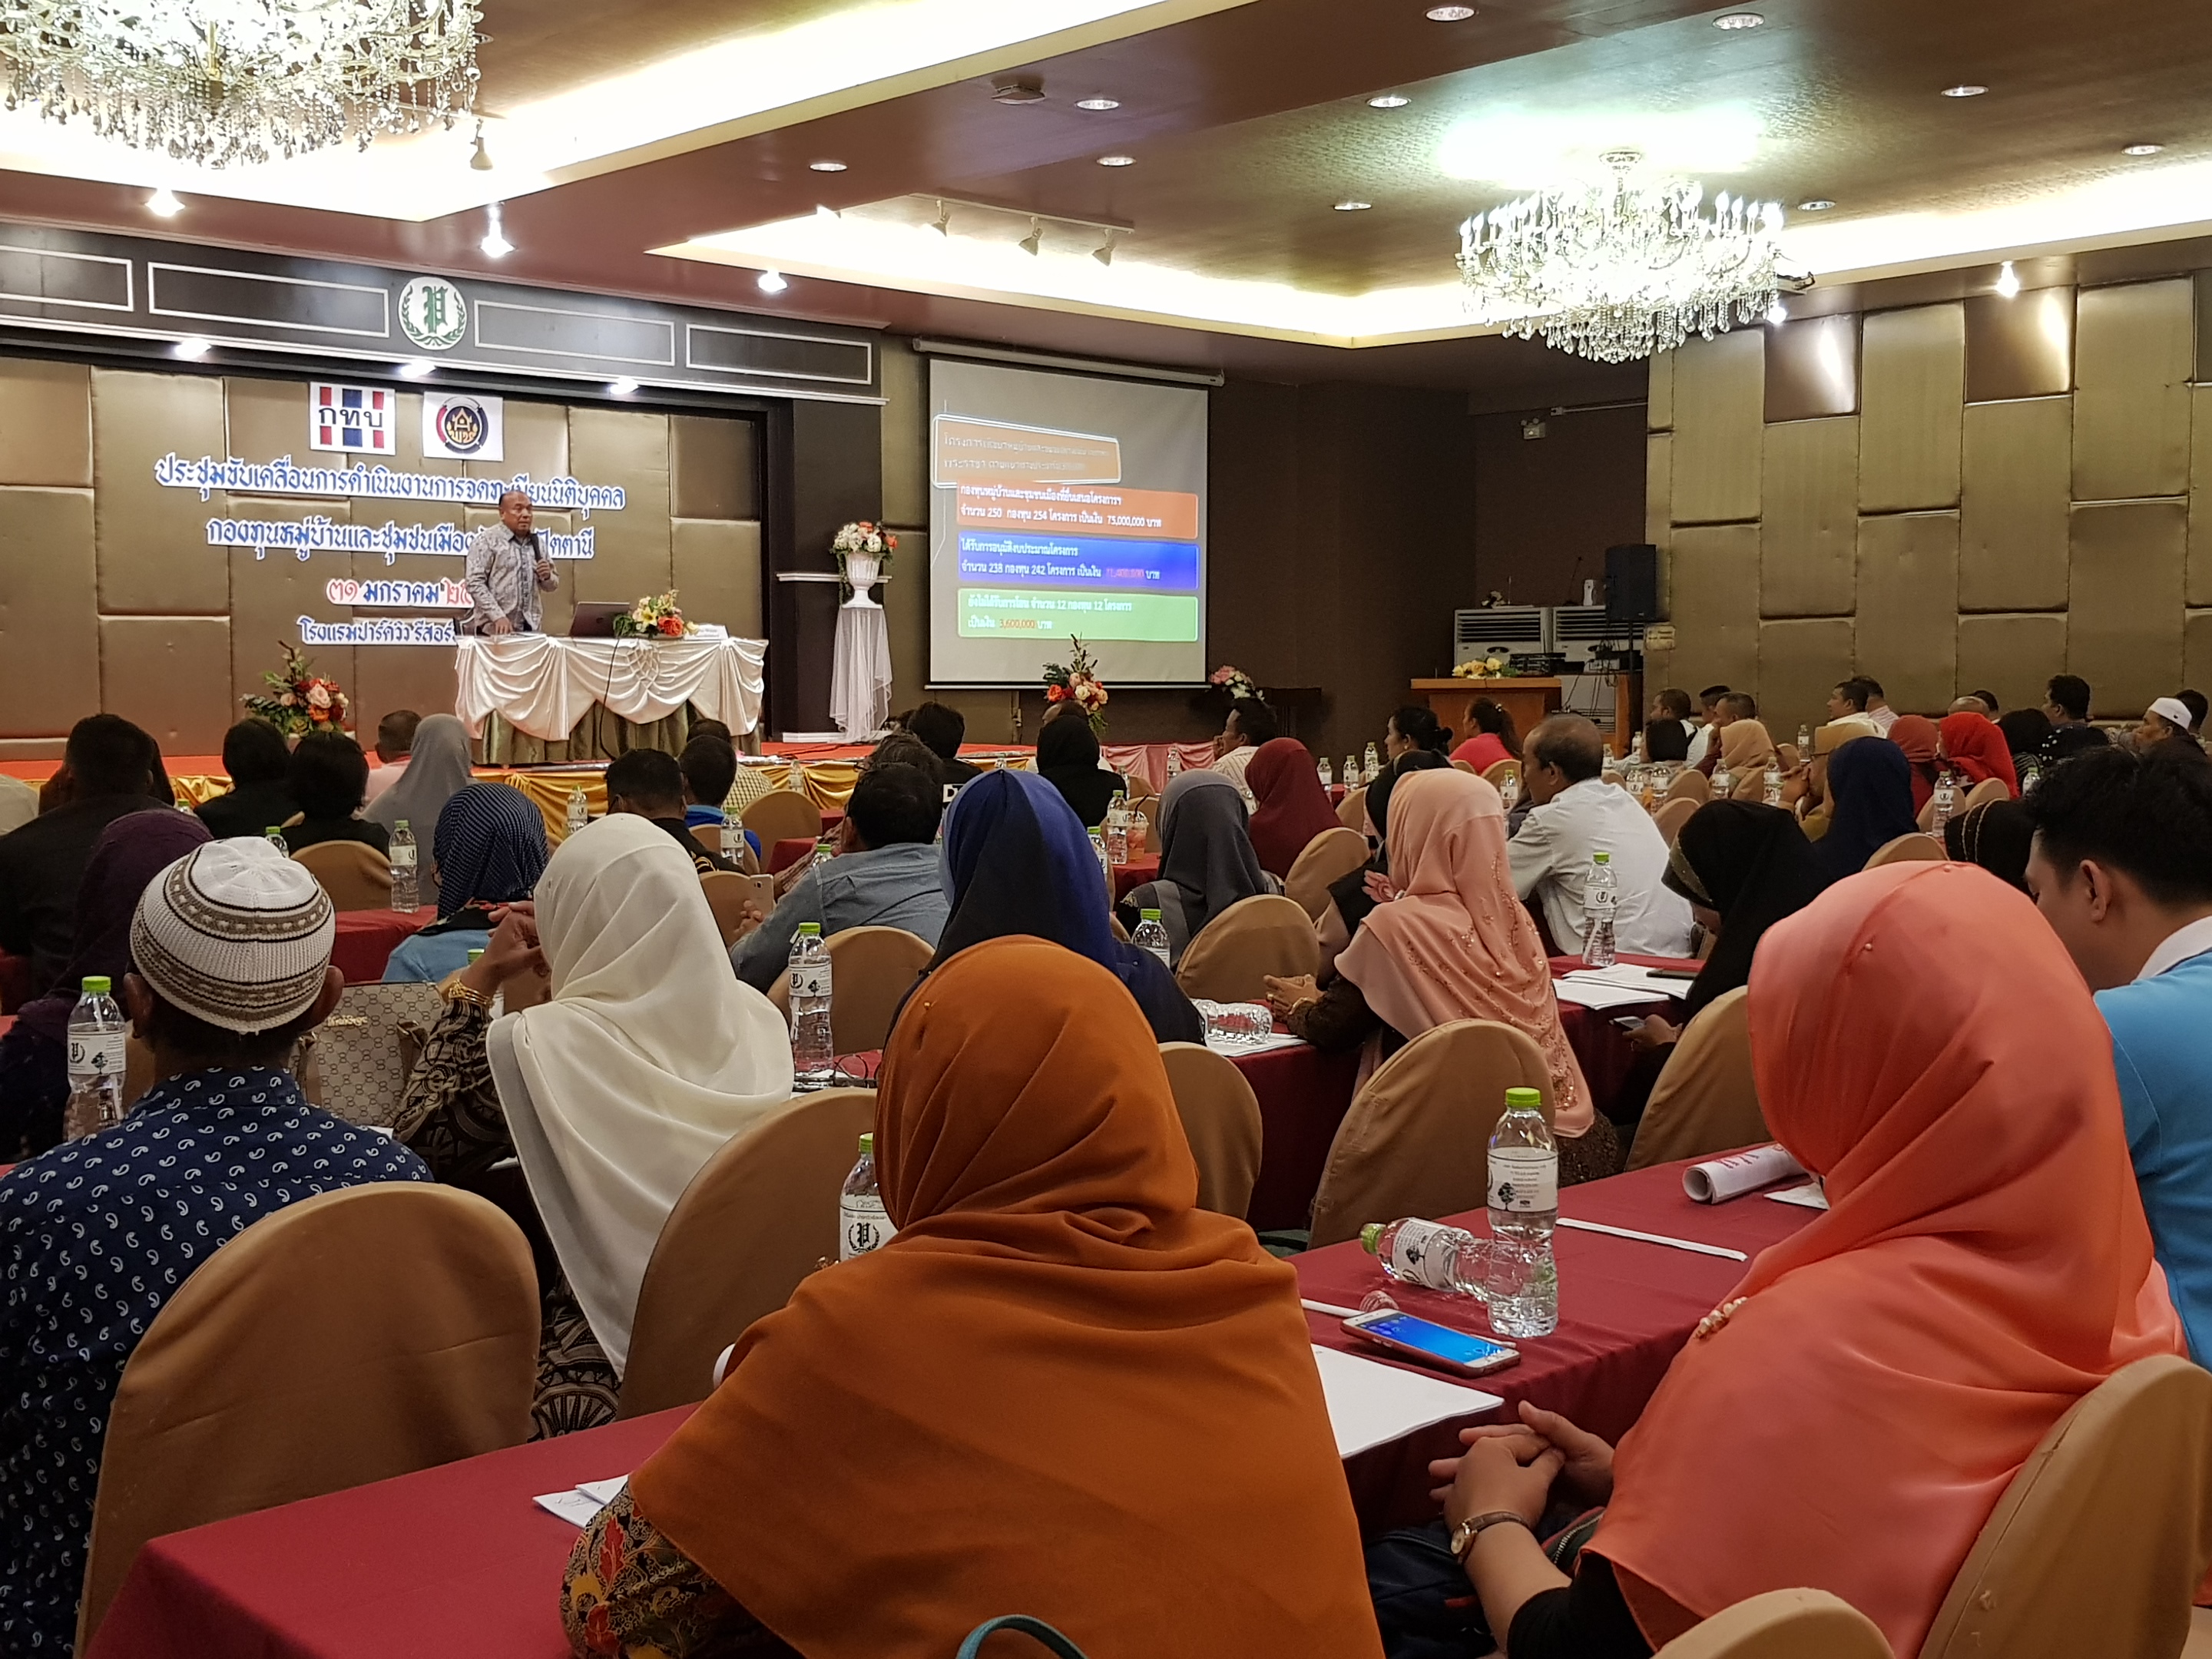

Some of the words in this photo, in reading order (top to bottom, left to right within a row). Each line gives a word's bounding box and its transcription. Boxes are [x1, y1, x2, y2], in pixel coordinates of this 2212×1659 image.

[318, 408, 382, 428] กทบ
[960, 503, 986, 517] จำนวน
[987, 508, 1002, 518] 250
[1006, 508, 1031, 522] กองทุน
[1033, 511, 1047, 521] 254
[1048, 508, 1077, 522] โครงการ
[1078, 510, 1103, 524] เป็นเงิน
[1107, 515, 1145, 527] 75,000,000
[1146, 518, 1162, 528] บาท
[962, 559, 986, 572] จำนวน
[988, 563, 1003, 574] 238
[1005, 565, 1030, 578] กองทุน
[1031, 565, 1046, 575] 242
[1047, 562, 1075, 576] โครงการ
[1077, 563, 1101, 578] เป็นเงิน
[1145, 570, 1160, 580] บาท
[329, 580, 359, 601] ๓๑
[363, 582, 439, 604] มกราคม
[1031, 596, 1055, 610] จำนวน
[1057, 600, 1067, 610] 12
[1094, 601, 1103, 611] 12
[1104, 598, 1132, 611] โครงการ
[414, 615, 455, 643] รีสอร์
[1037, 621, 1053, 630] บาท
